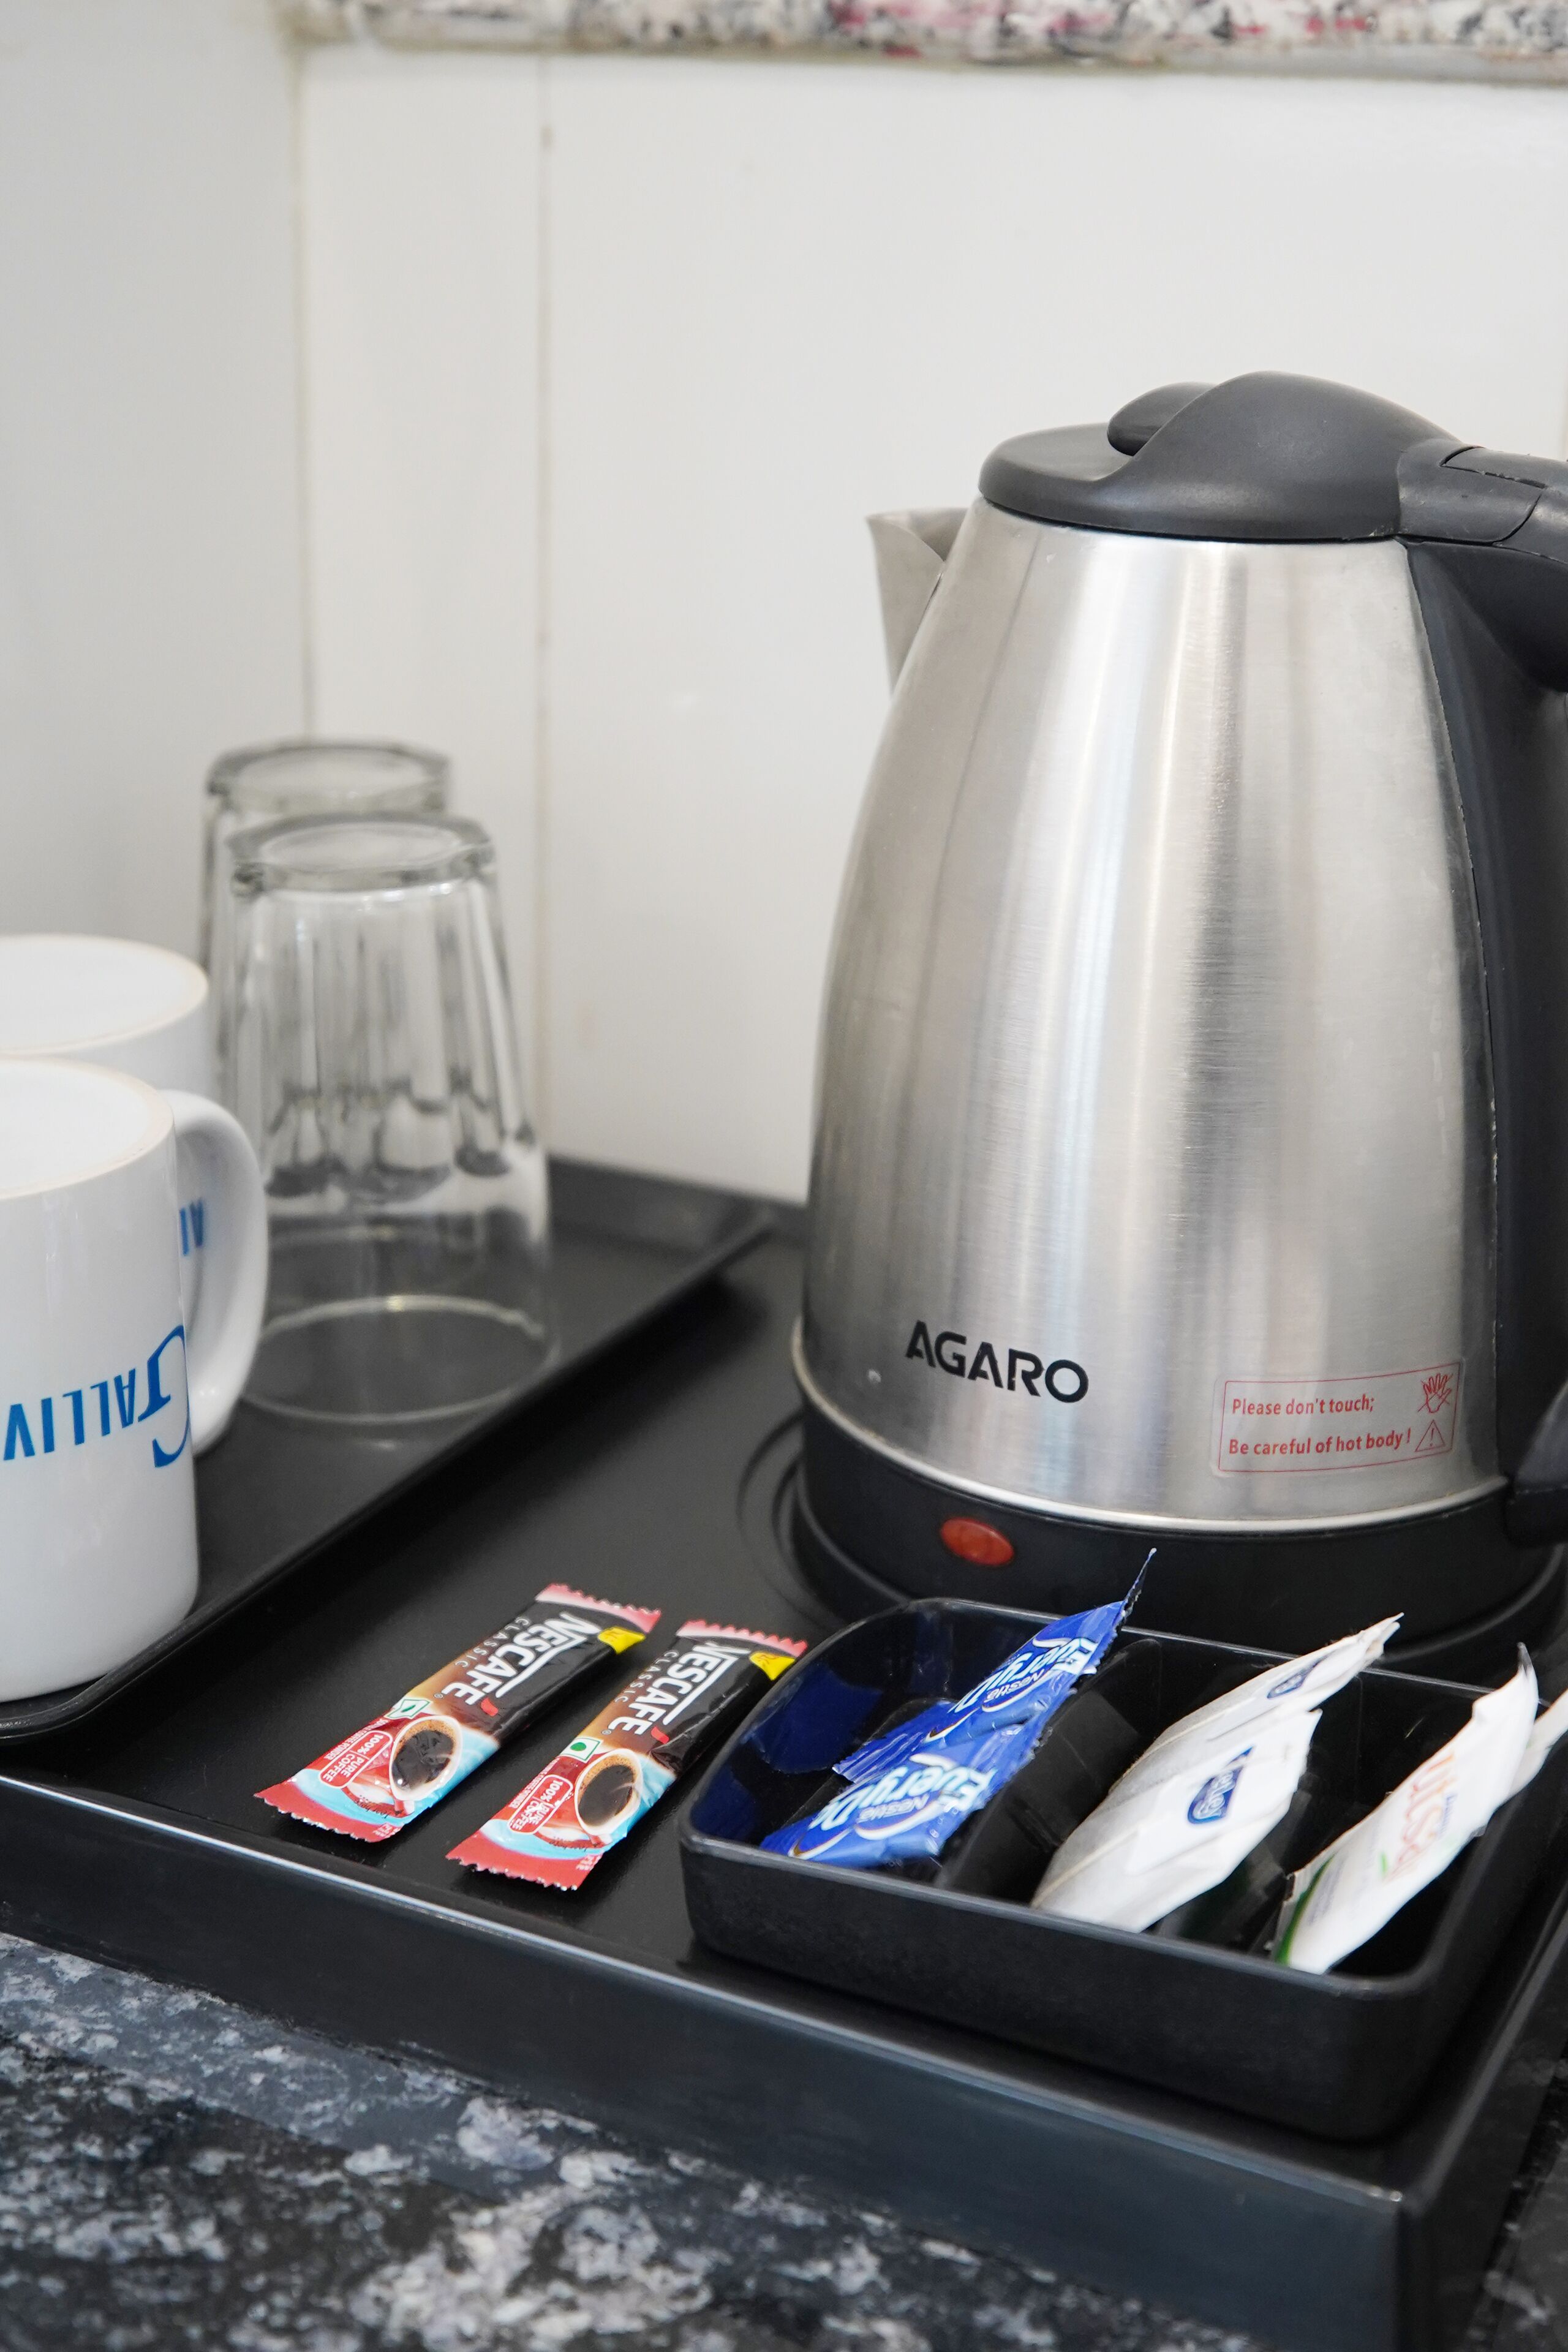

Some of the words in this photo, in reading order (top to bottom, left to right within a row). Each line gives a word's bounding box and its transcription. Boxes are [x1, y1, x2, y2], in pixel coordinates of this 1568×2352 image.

[904, 1320, 1089, 1404] AGARO
[1232, 1398, 1281, 1415] Please
[1286, 1397, 1325, 1415] don't
[1229, 1439, 1249, 1455] Be
[1254, 1438, 1311, 1455] careful
[1316, 1436, 1333, 1453] of
[1336, 1434, 1362, 1452] hot
[454, 1616, 530, 1668] CLASSIC
[615, 1651, 679, 1703] CLASSIC
[356, 1734, 384, 1755] 100%
[323, 1754, 356, 1782] COFFEE
[341, 1756, 365, 1777] PURE
[540, 1779, 564, 1802] 100%
